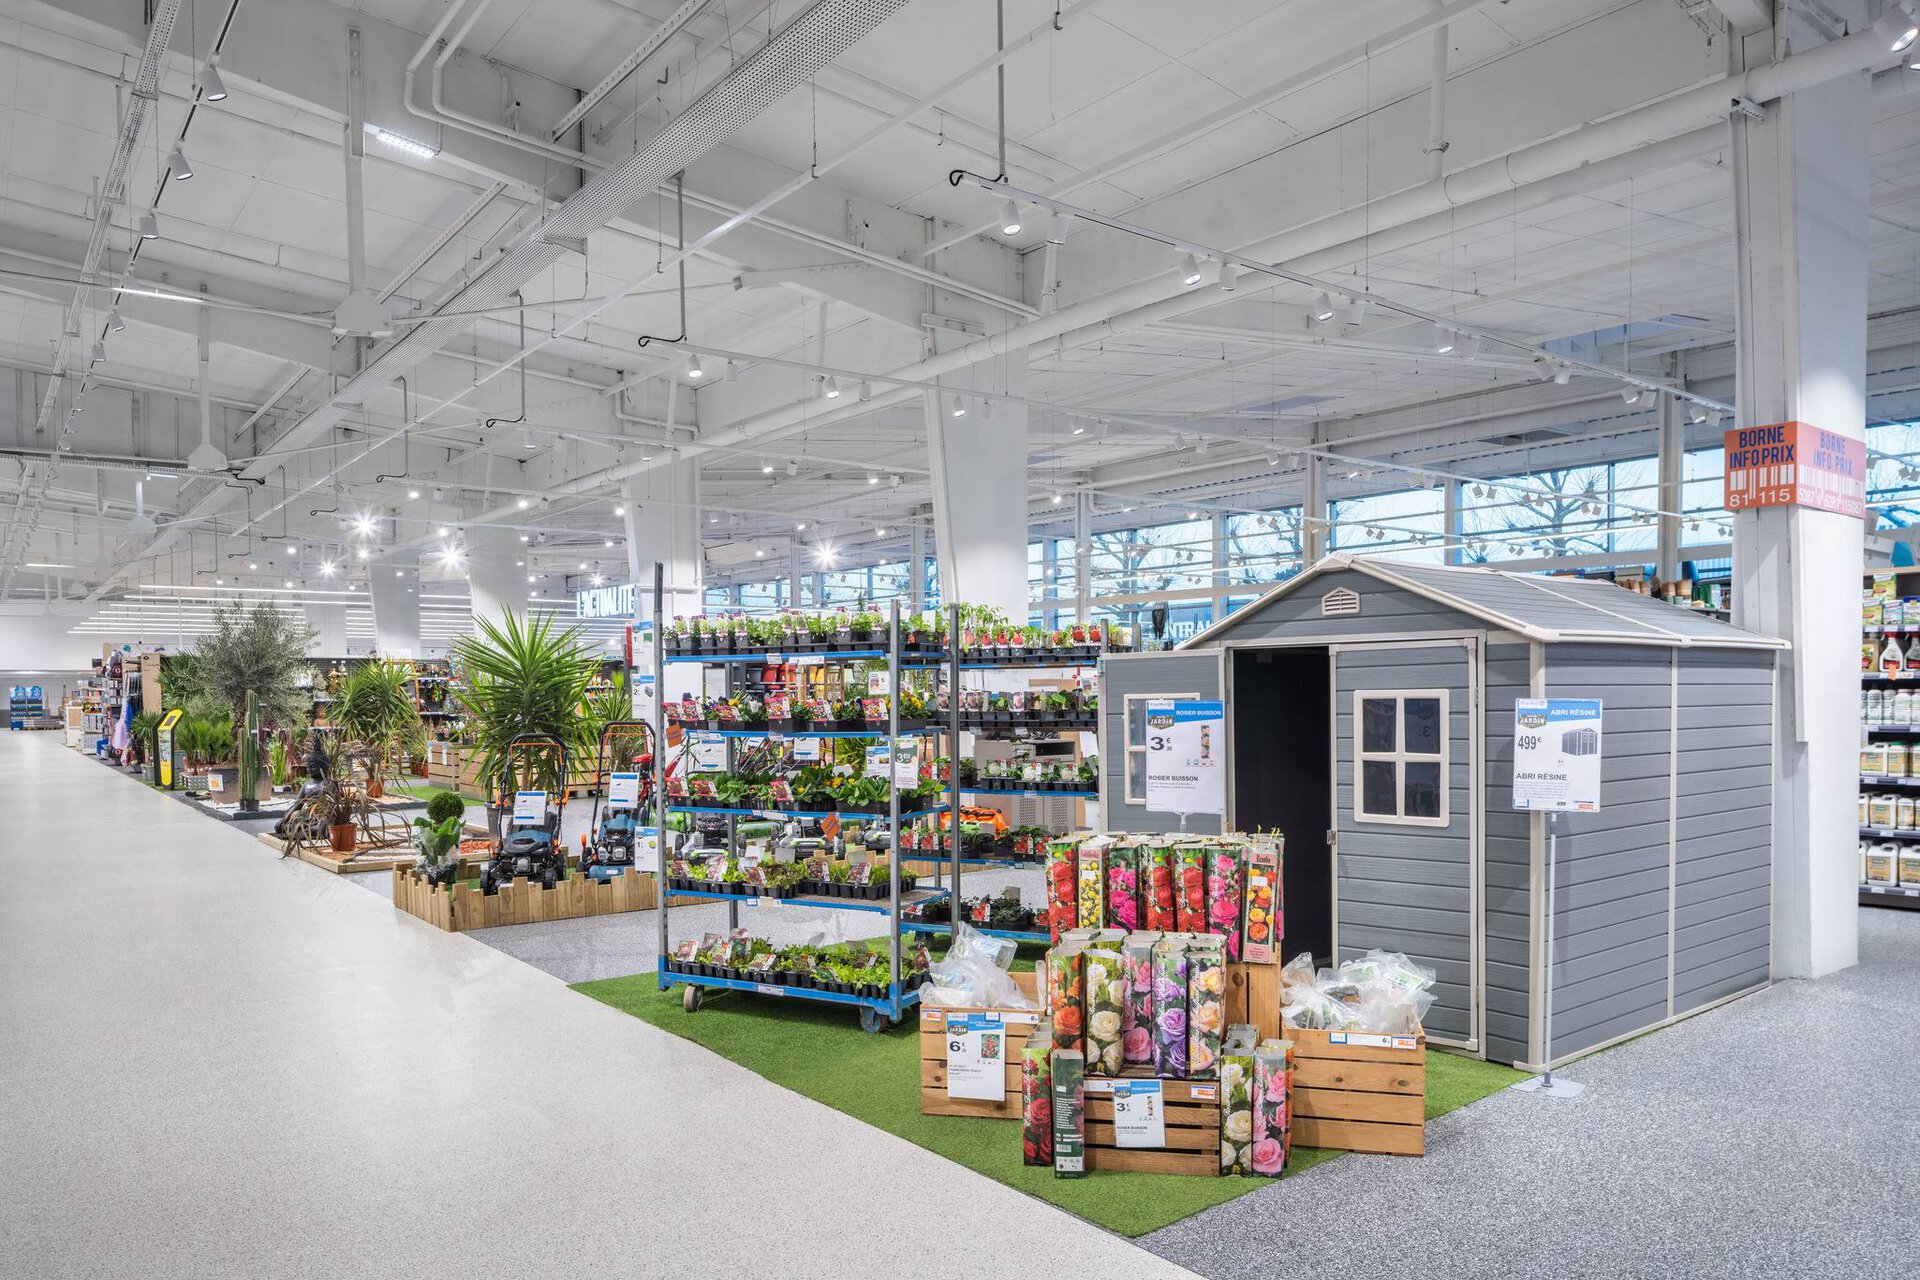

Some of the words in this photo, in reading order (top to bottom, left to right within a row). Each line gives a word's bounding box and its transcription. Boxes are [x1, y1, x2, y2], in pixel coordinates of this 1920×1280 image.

[1739, 426, 1785, 449] BORNE
[1820, 431, 1846, 456] BORNE
[1729, 449, 1759, 469] INFO
[1762, 444, 1794, 465] PRIX
[1813, 448, 1832, 470] INFO
[1835, 458, 1853, 477] PRIX
[1729, 492, 1749, 507] 81
[1759, 488, 1790, 504] 115
[1569, 708, 1597, 716] RÉSINE
[1150, 736, 1165, 751] 3
[1537, 773, 1568, 781] RÉSINE
[949, 1041, 961, 1052] 6
[1116, 1102, 1126, 1112] 3
